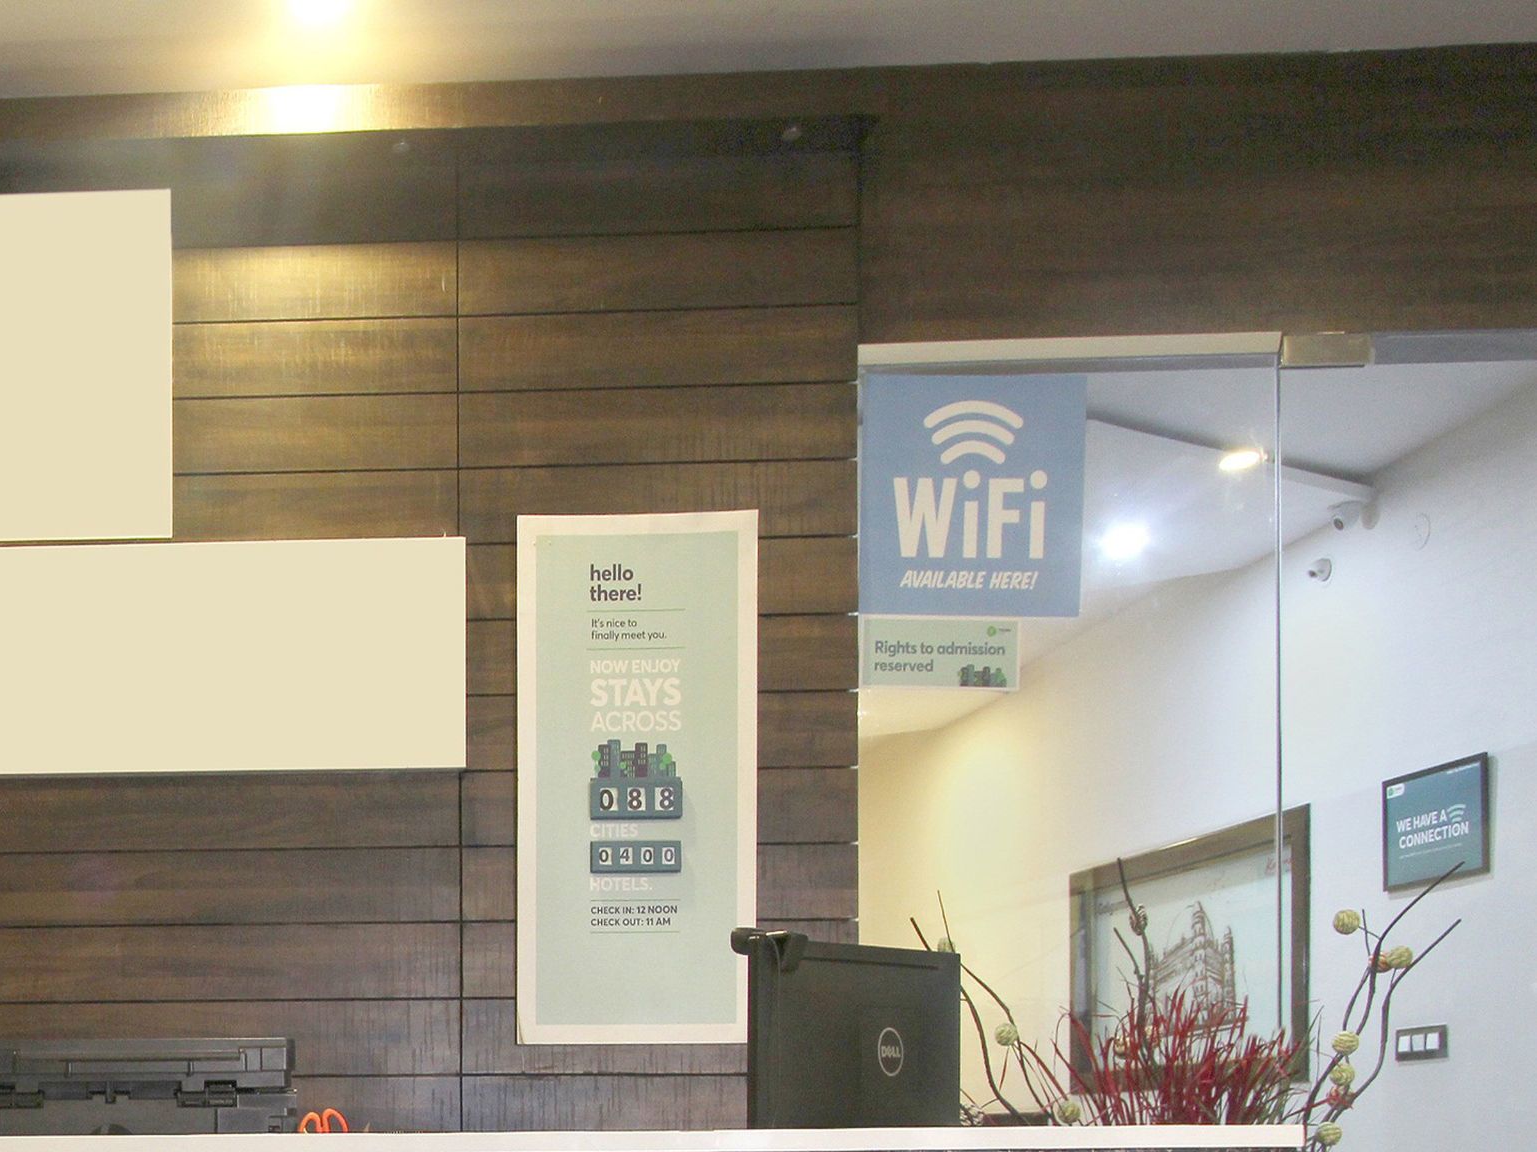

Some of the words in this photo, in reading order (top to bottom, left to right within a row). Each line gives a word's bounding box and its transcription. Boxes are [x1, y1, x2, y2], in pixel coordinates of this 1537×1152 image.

[893, 469, 1048, 560] WiFi
[590, 563, 634, 581] hello
[899, 569, 984, 589] AVAILABLE
[989, 570, 1039, 590] HERE!
[589, 583, 642, 602] there!
[591, 618, 605, 628] It's
[606, 618, 626, 628] nice
[628, 618, 638, 628] to
[591, 630, 619, 641] finally
[621, 631, 645, 640] meet
[647, 631, 667, 641] you.
[874, 641, 918, 658] Rights
[919, 642, 934, 656] to
[936, 640, 1006, 656] admission
[590, 660, 629, 674] NOW
[631, 659, 681, 673] ENJOY
[874, 658, 934, 673] reserved
[590, 677, 682, 707] STAYS
[590, 711, 682, 732] ACROSS
[1396, 818, 1412, 832] WE
[1413, 811, 1438, 828] HAVE
[1439, 809, 1447, 822] A
[590, 823, 639, 838] CITIES
[1399, 821, 1469, 849] CONNECTION
[590, 876, 653, 891] HOTELS.
[590, 906, 621, 914] CHECK
[622, 906, 635, 914] IN:
[636, 905, 646, 914] 12
[647, 905, 678, 914] NOON
[590, 918, 621, 927] CHECK
[622, 918, 644, 927] OUT:
[646, 918, 654, 926] 11
[655, 917, 671, 926] AM
[881, 1045, 901, 1058] DELL
